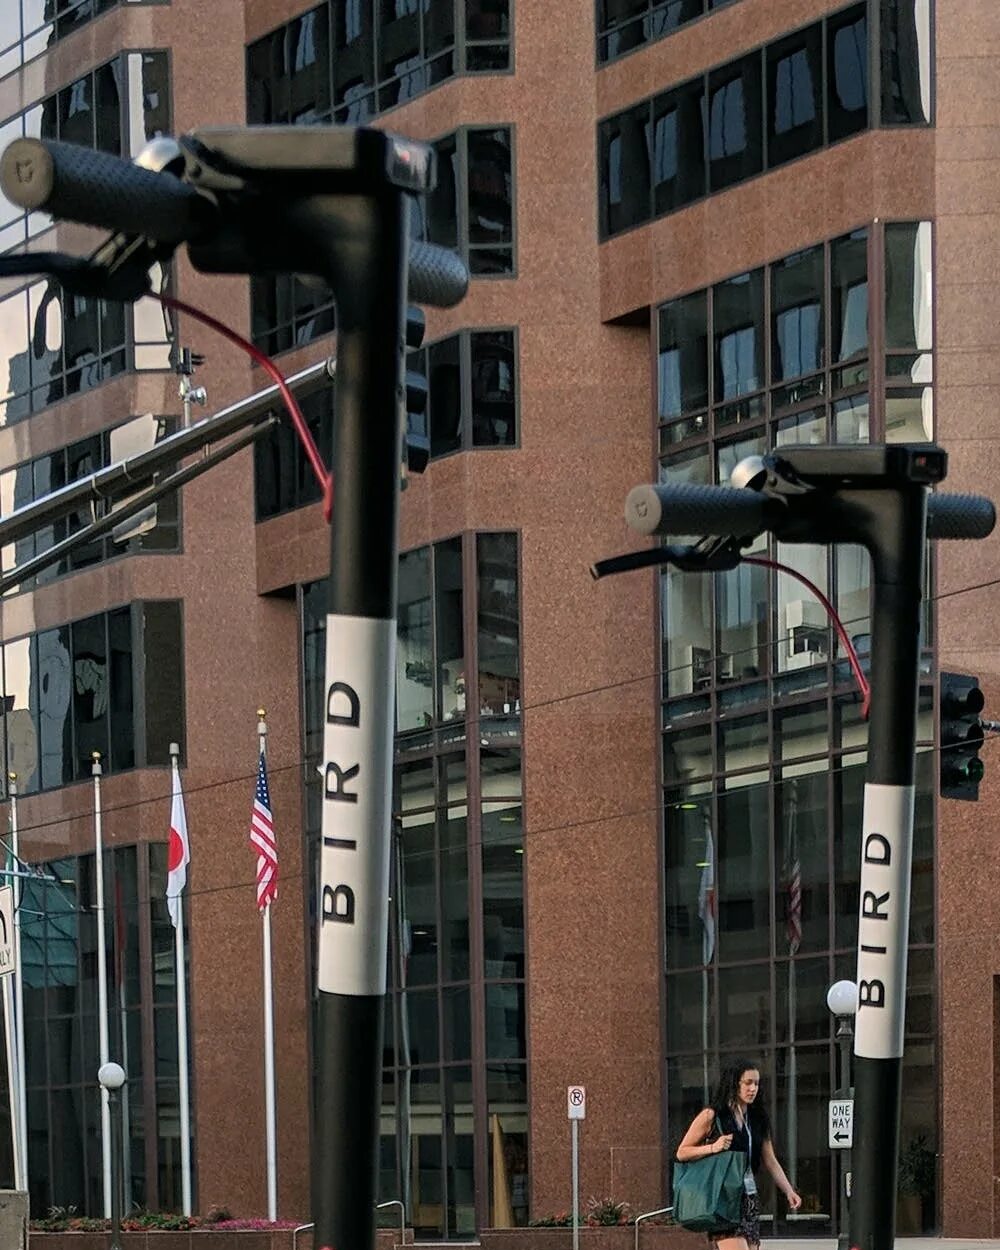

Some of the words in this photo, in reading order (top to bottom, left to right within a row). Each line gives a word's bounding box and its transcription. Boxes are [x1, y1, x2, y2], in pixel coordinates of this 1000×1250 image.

[322, 681, 360, 926] BIRD
[858, 833, 892, 1010] BIRD
[832, 1105, 850, 1116] ONE
[832, 1118, 850, 1128] WAY
